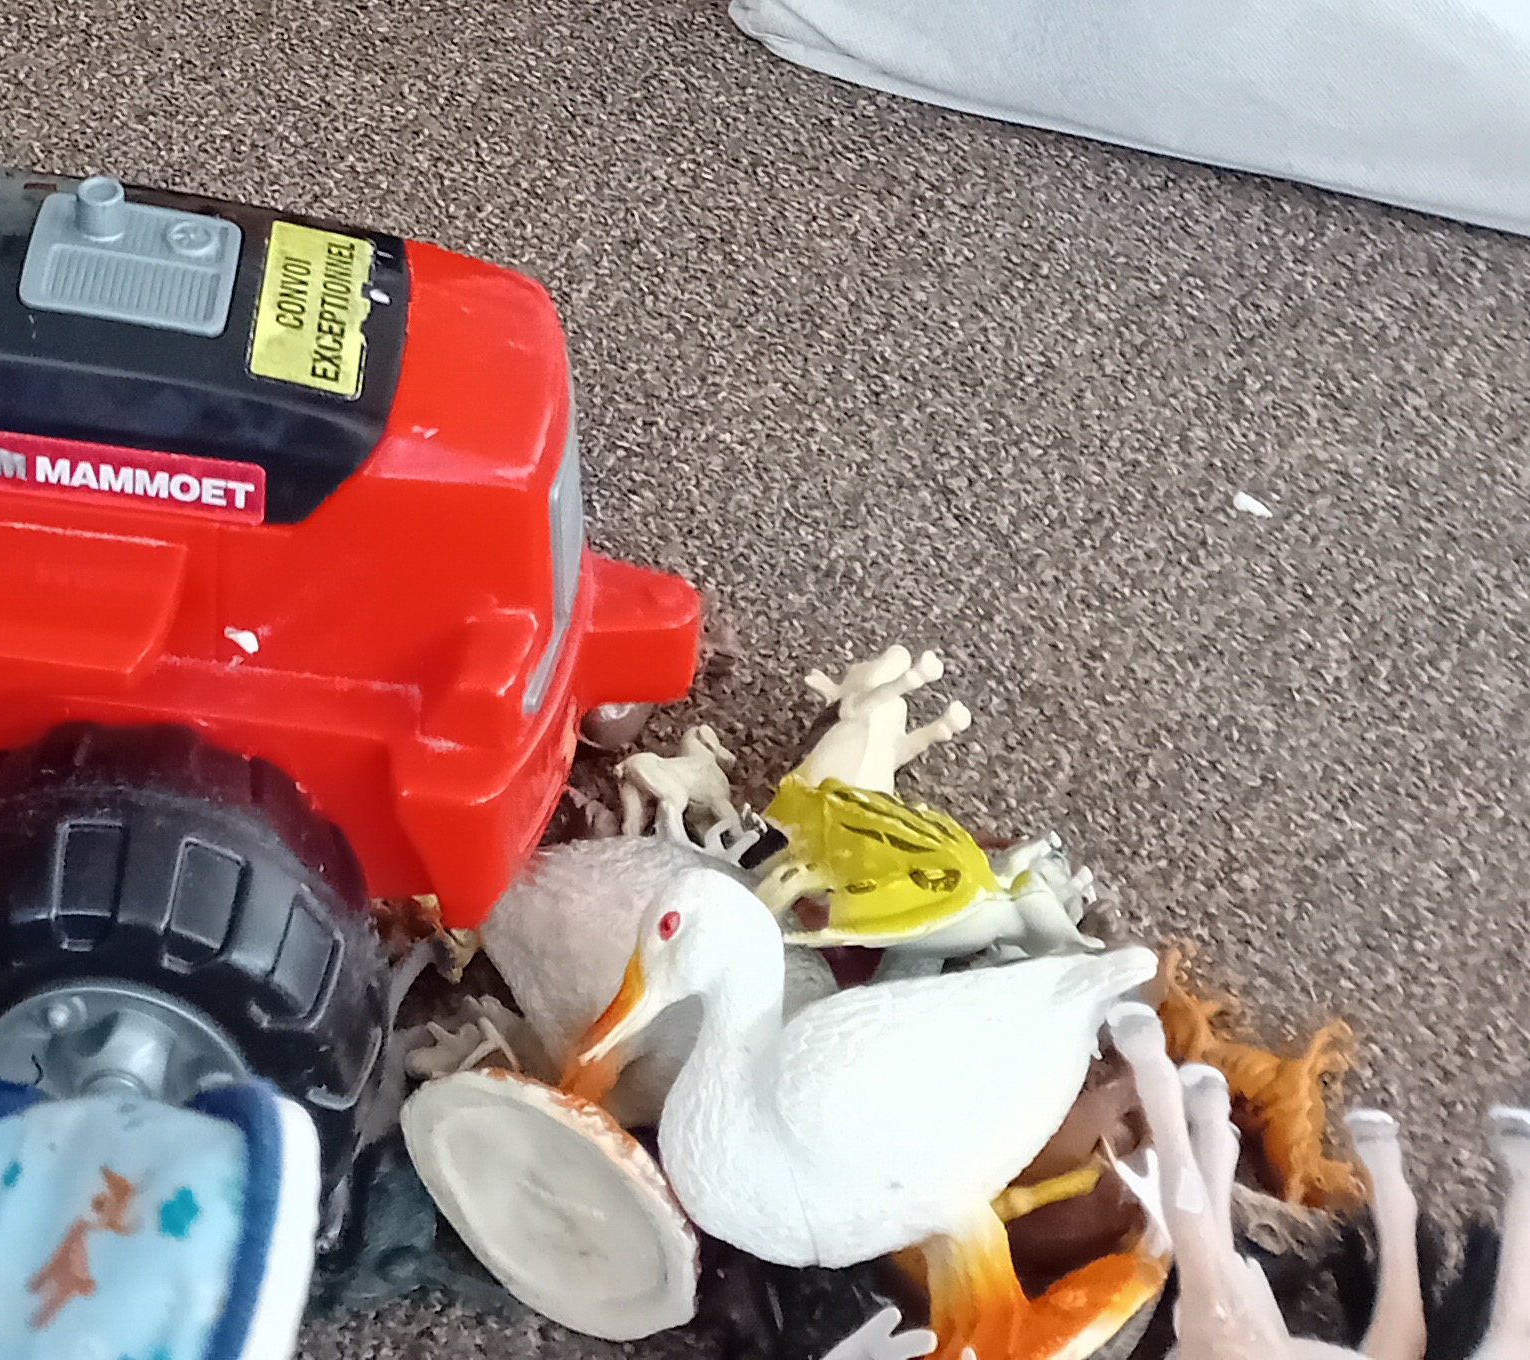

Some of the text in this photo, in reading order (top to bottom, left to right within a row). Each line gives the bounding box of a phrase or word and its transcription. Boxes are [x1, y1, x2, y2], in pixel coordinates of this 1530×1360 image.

[275, 255, 312, 330] CONVOI
[310, 241, 356, 384] EXCEPTIONNEL
[35, 455, 255, 509] MAMMOET
